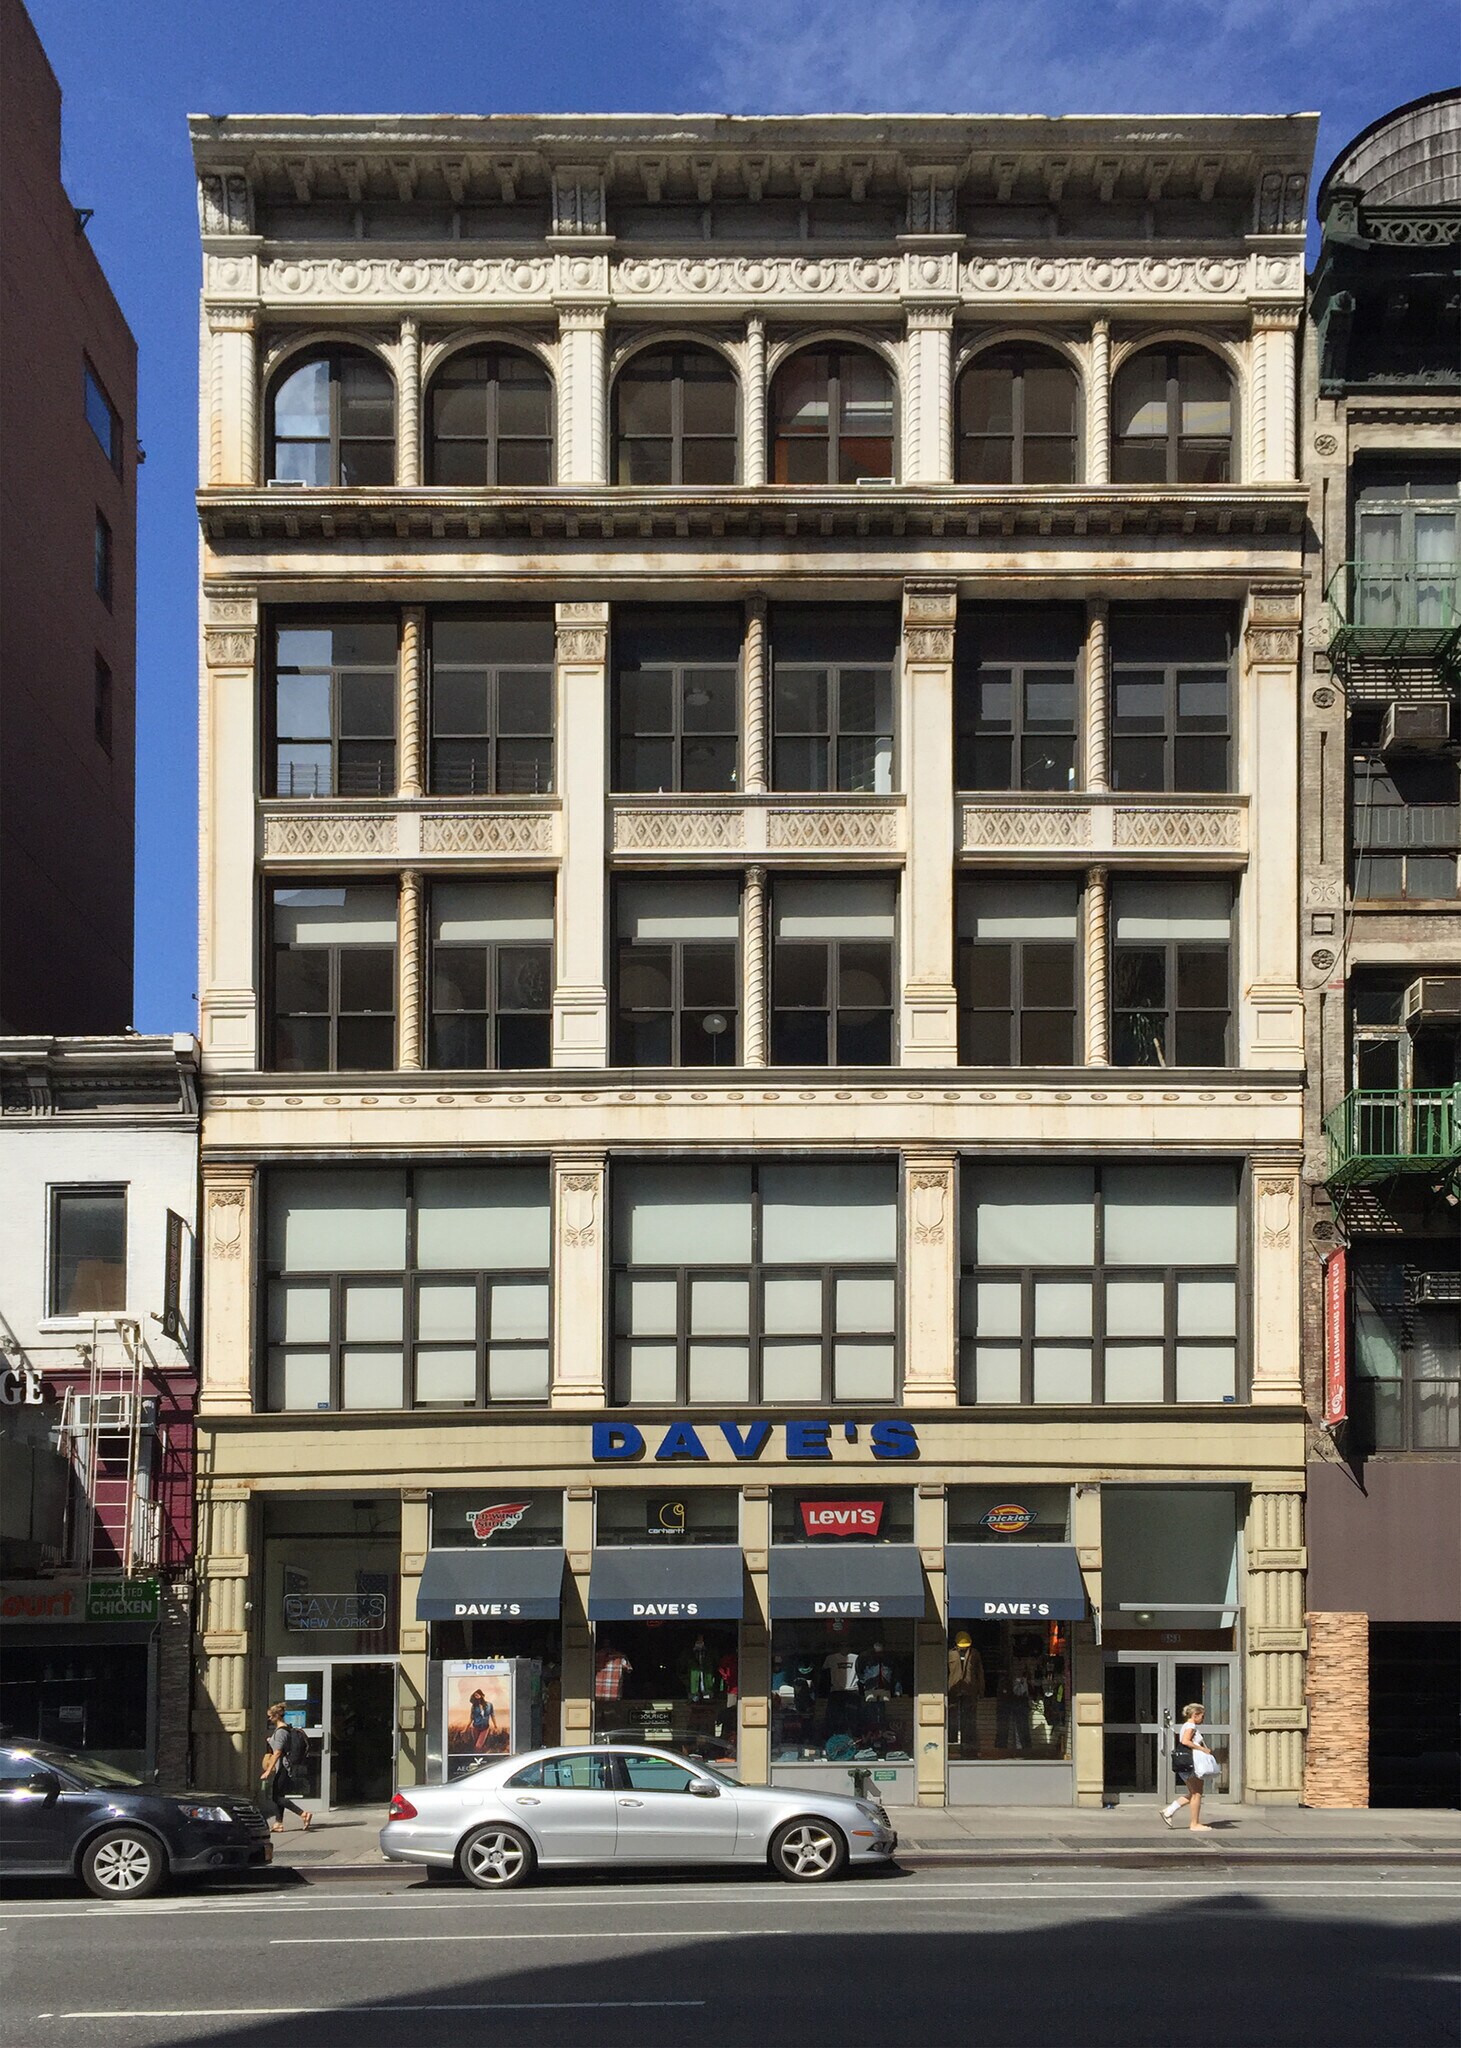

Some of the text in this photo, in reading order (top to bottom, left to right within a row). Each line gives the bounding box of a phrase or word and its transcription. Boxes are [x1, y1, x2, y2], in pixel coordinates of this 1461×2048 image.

[0, 1370, 43, 1405] GE
[592, 1420, 919, 1461] DAVE'S
[986, 1514, 1031, 1522] Dickies
[100, 1587, 143, 1598] ROASTED
[91, 1600, 153, 1614] CHICKEN
[286, 1597, 383, 1617] DAVE'S
[455, 1603, 521, 1615] DAVE'S
[633, 1603, 698, 1615] DAVE'S
[814, 1601, 880, 1613] DAVE'S
[984, 1602, 1050, 1615] DAVE'S
[300, 1618, 369, 1629] NEW YORK
[465, 1663, 496, 1671] Phone
